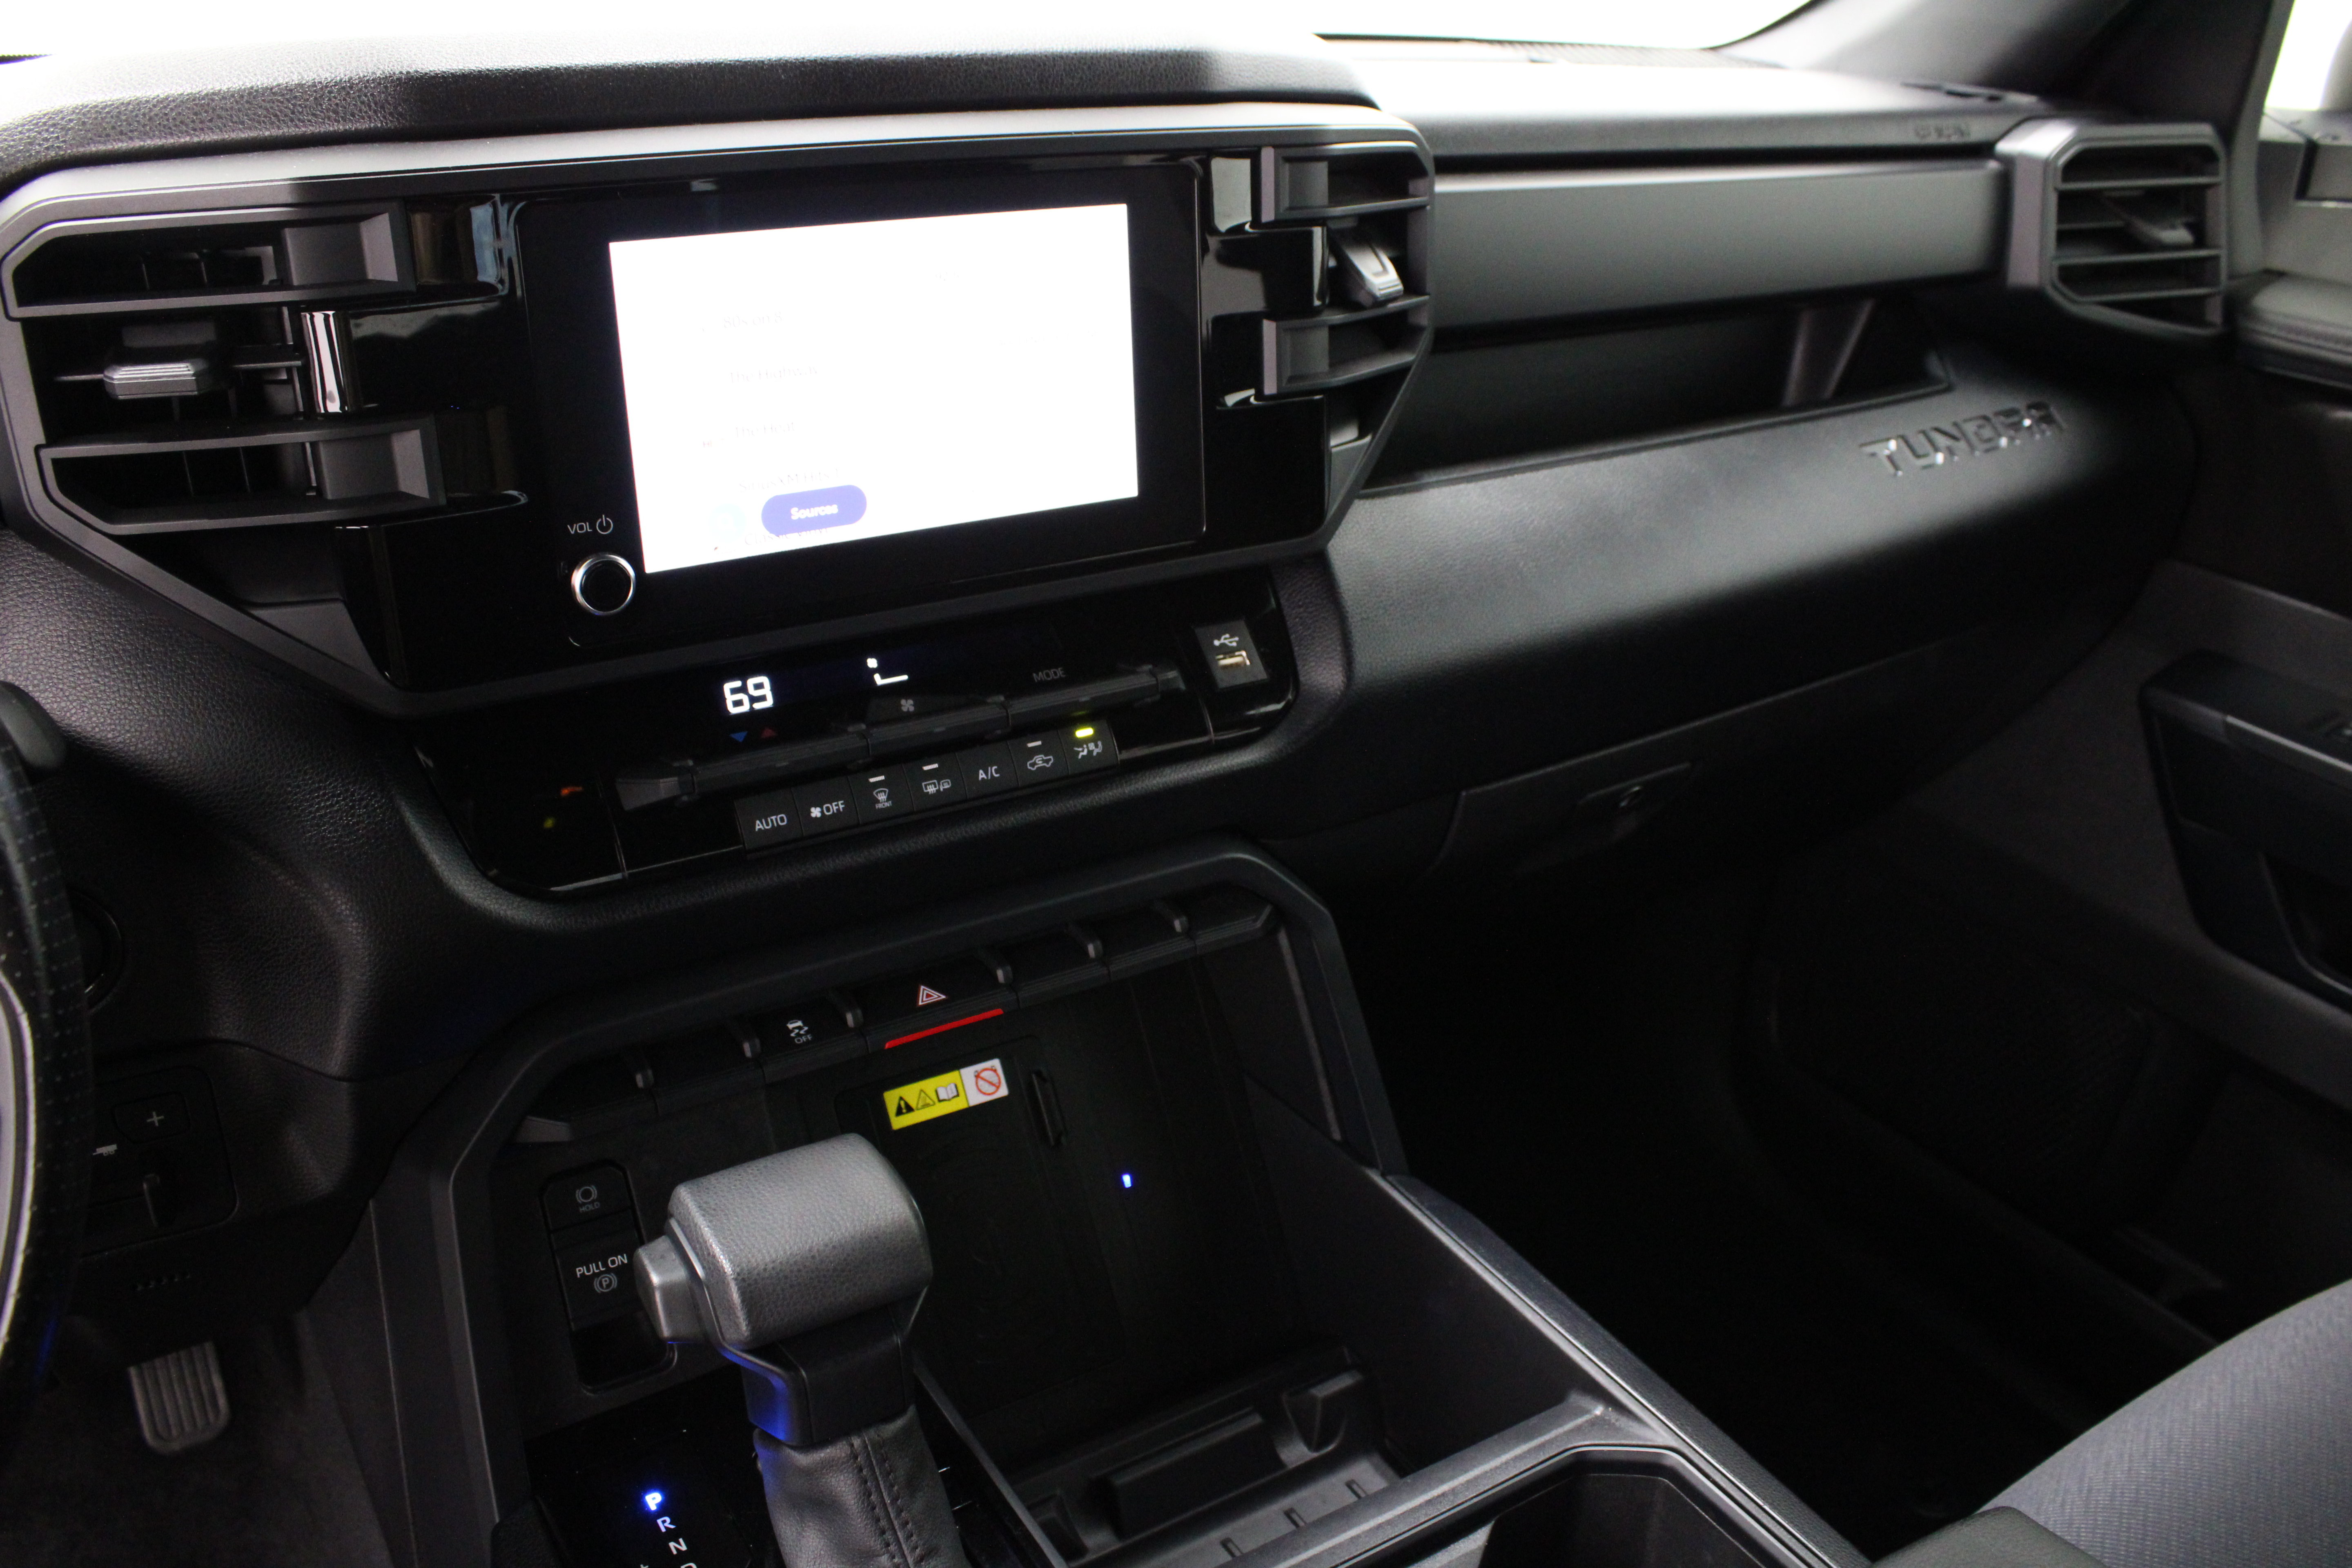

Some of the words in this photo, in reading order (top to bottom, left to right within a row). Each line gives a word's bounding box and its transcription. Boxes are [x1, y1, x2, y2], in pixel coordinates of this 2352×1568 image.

[1859, 401, 2066, 477] TUNDRA
[791, 504, 839, 520] Sources
[567, 522, 592, 534] VOL
[1032, 667, 1067, 683] MODE
[723, 675, 774, 715] 69
[978, 766, 1000, 781] A/C
[822, 800, 845, 815] OFF
[875, 800, 892, 809] FRONT
[755, 813, 787, 831] AUTO
[794, 1034, 812, 1045] OFF
[579, 1201, 601, 1213] HOLD
[575, 1261, 606, 1278] PULL
[608, 1253, 628, 1268] ON
[645, 1492, 662, 1511] P
[656, 1516, 676, 1532] R
[668, 1537, 688, 1555] N
